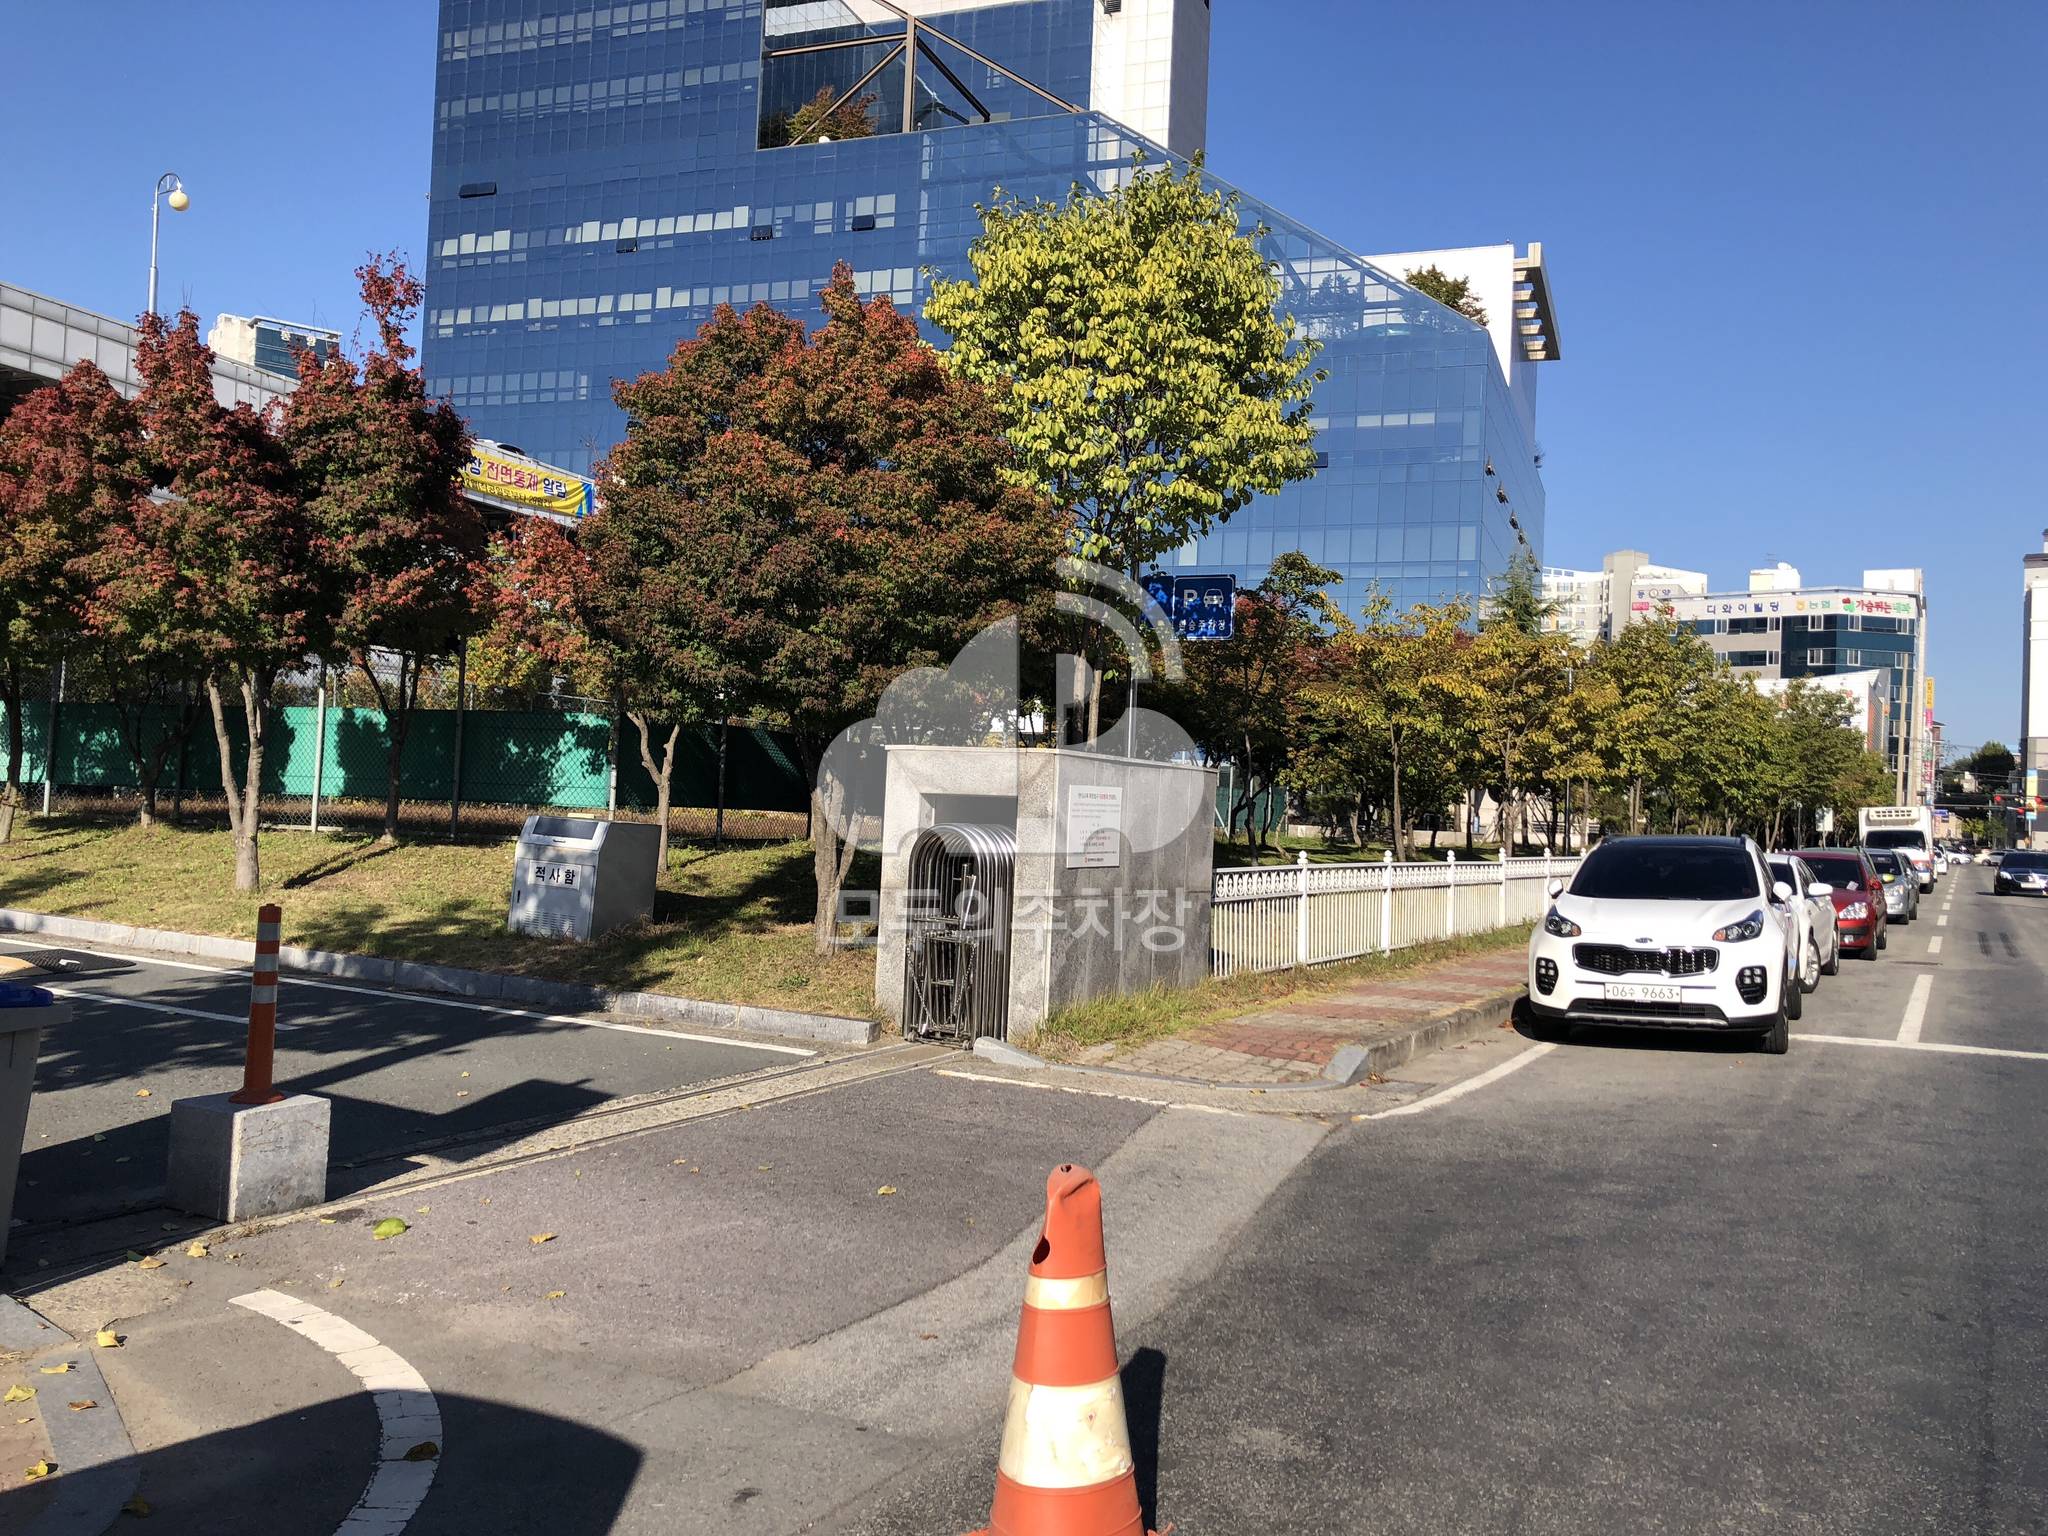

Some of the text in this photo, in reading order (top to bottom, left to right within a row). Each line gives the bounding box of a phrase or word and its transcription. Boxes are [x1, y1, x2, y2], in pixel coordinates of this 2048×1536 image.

[487, 461, 538, 491] 전면통제
[543, 477, 568, 499] 알림
[1183, 589, 1198, 608] P
[535, 866, 576, 885] 적사함
[1612, 986, 1674, 1000] 06수 9663
